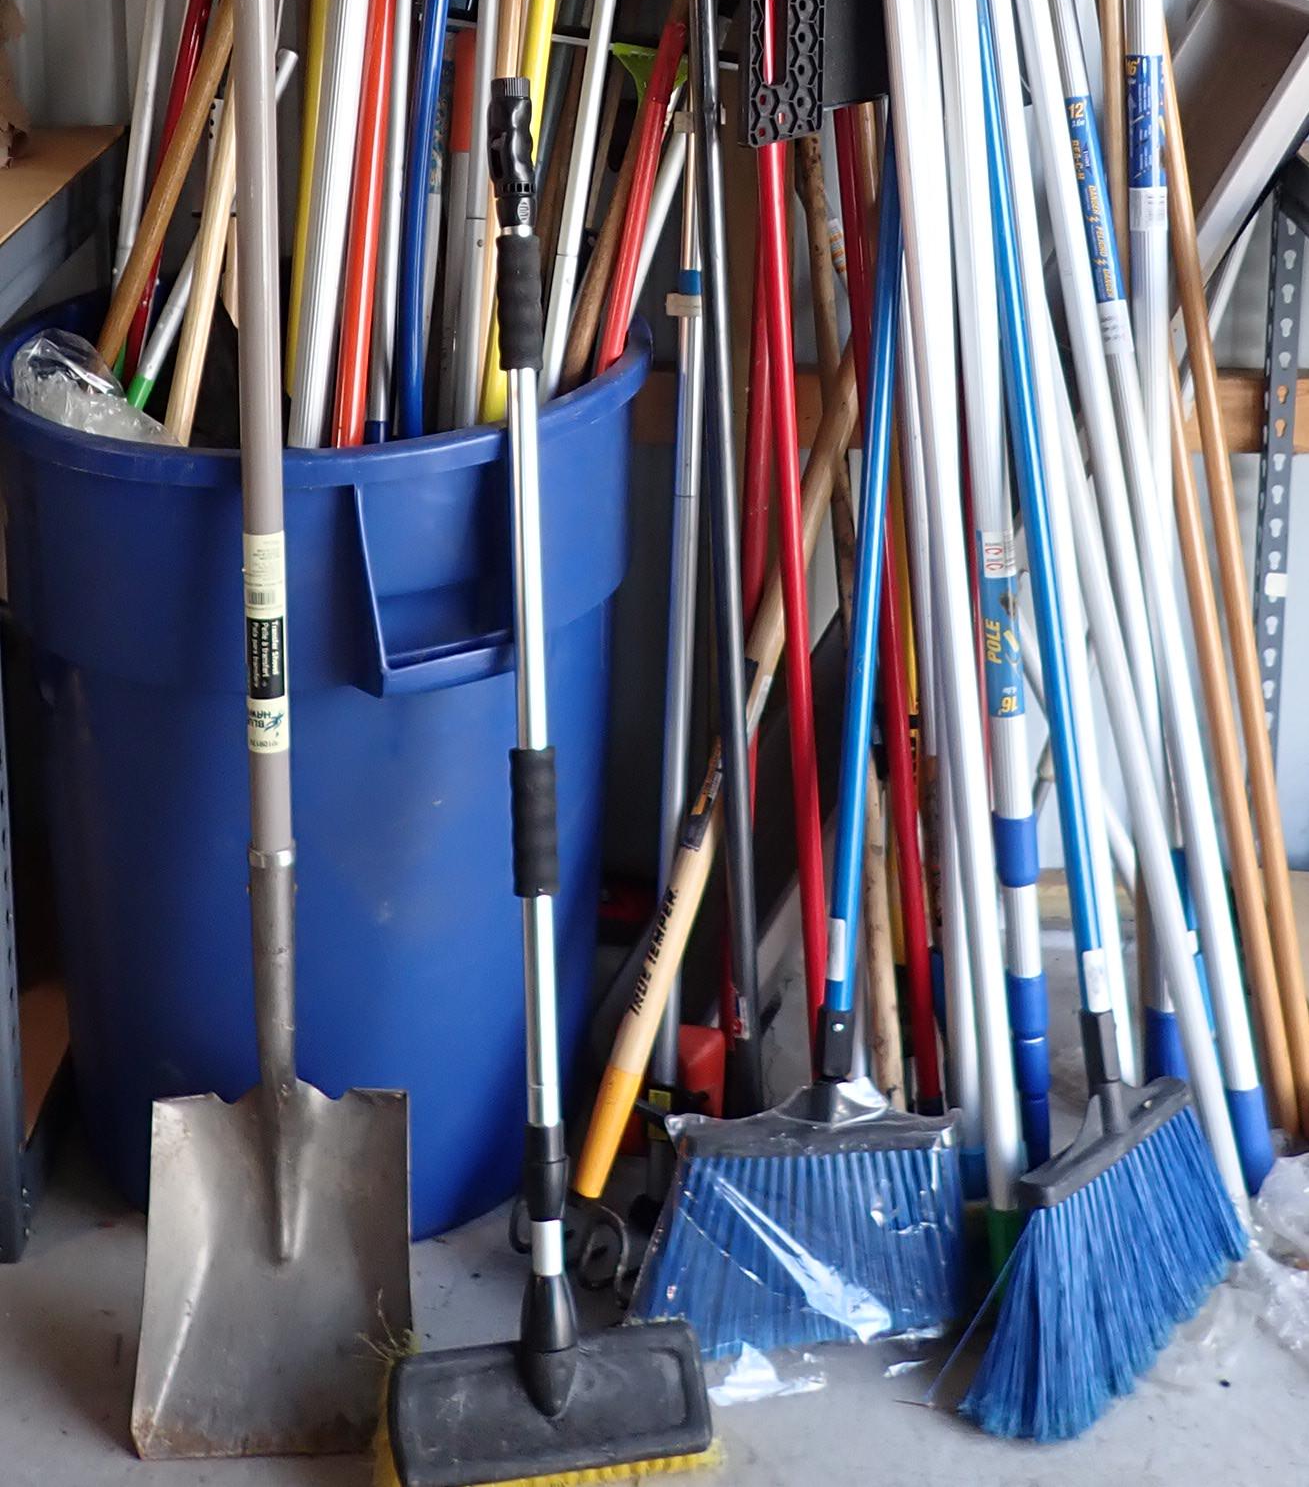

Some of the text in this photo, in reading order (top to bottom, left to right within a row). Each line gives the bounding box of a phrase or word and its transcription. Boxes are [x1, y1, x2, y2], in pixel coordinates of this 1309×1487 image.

[271, 619, 279, 675] Transfer Shovel
[986, 618, 1002, 664] POLE
